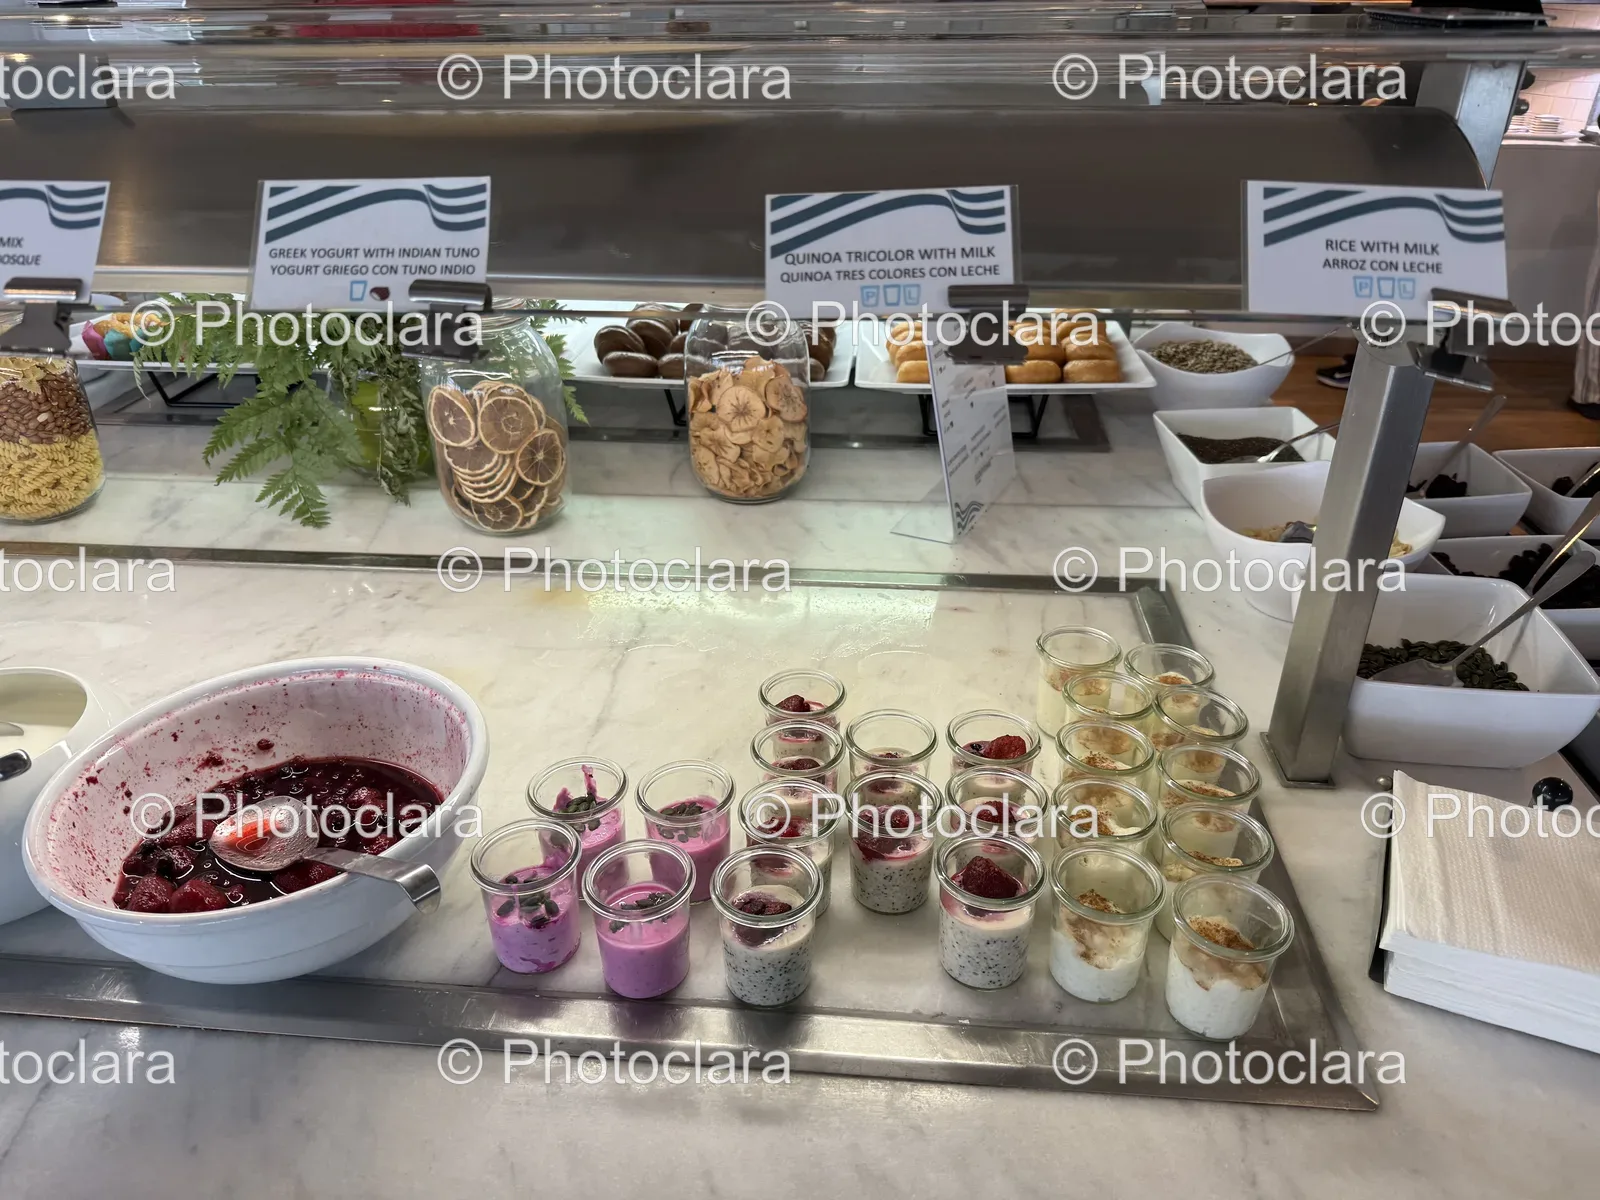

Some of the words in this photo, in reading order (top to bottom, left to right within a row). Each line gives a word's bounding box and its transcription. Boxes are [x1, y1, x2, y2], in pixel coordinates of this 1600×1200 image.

[0, 236, 24, 248] MIX
[1325, 238, 1357, 253] RICE
[1360, 240, 1399, 254] WITH
[1403, 242, 1440, 256] MILK
[0, 253, 42, 266] OSQUE
[269, 247, 307, 259] GREEK
[310, 247, 360, 259] YOGURT
[363, 247, 395, 259] WITH
[398, 247, 441, 259] INDIAN
[444, 247, 480, 259] TUNO
[784, 252, 842, 266] QUINOA
[846, 249, 915, 264] TRICOLOR
[919, 247, 956, 260] WITH
[961, 245, 996, 259] MILK
[270, 264, 320, 276] YOGURT
[322, 264, 369, 276] GRIEGO
[371, 264, 399, 276] CON
[401, 264, 437, 276] TUNO
[440, 264, 476, 276] INDIO
[1322, 258, 1367, 271] ARROZ
[1369, 260, 1399, 272] CON
[1402, 261, 1443, 274] LECHE
[780, 270, 833, 283] QUINOA
[836, 269, 865, 281] TRES
[868, 267, 926, 280] COLORES
[929, 266, 957, 278] CON
[960, 264, 1000, 277] LECHE
